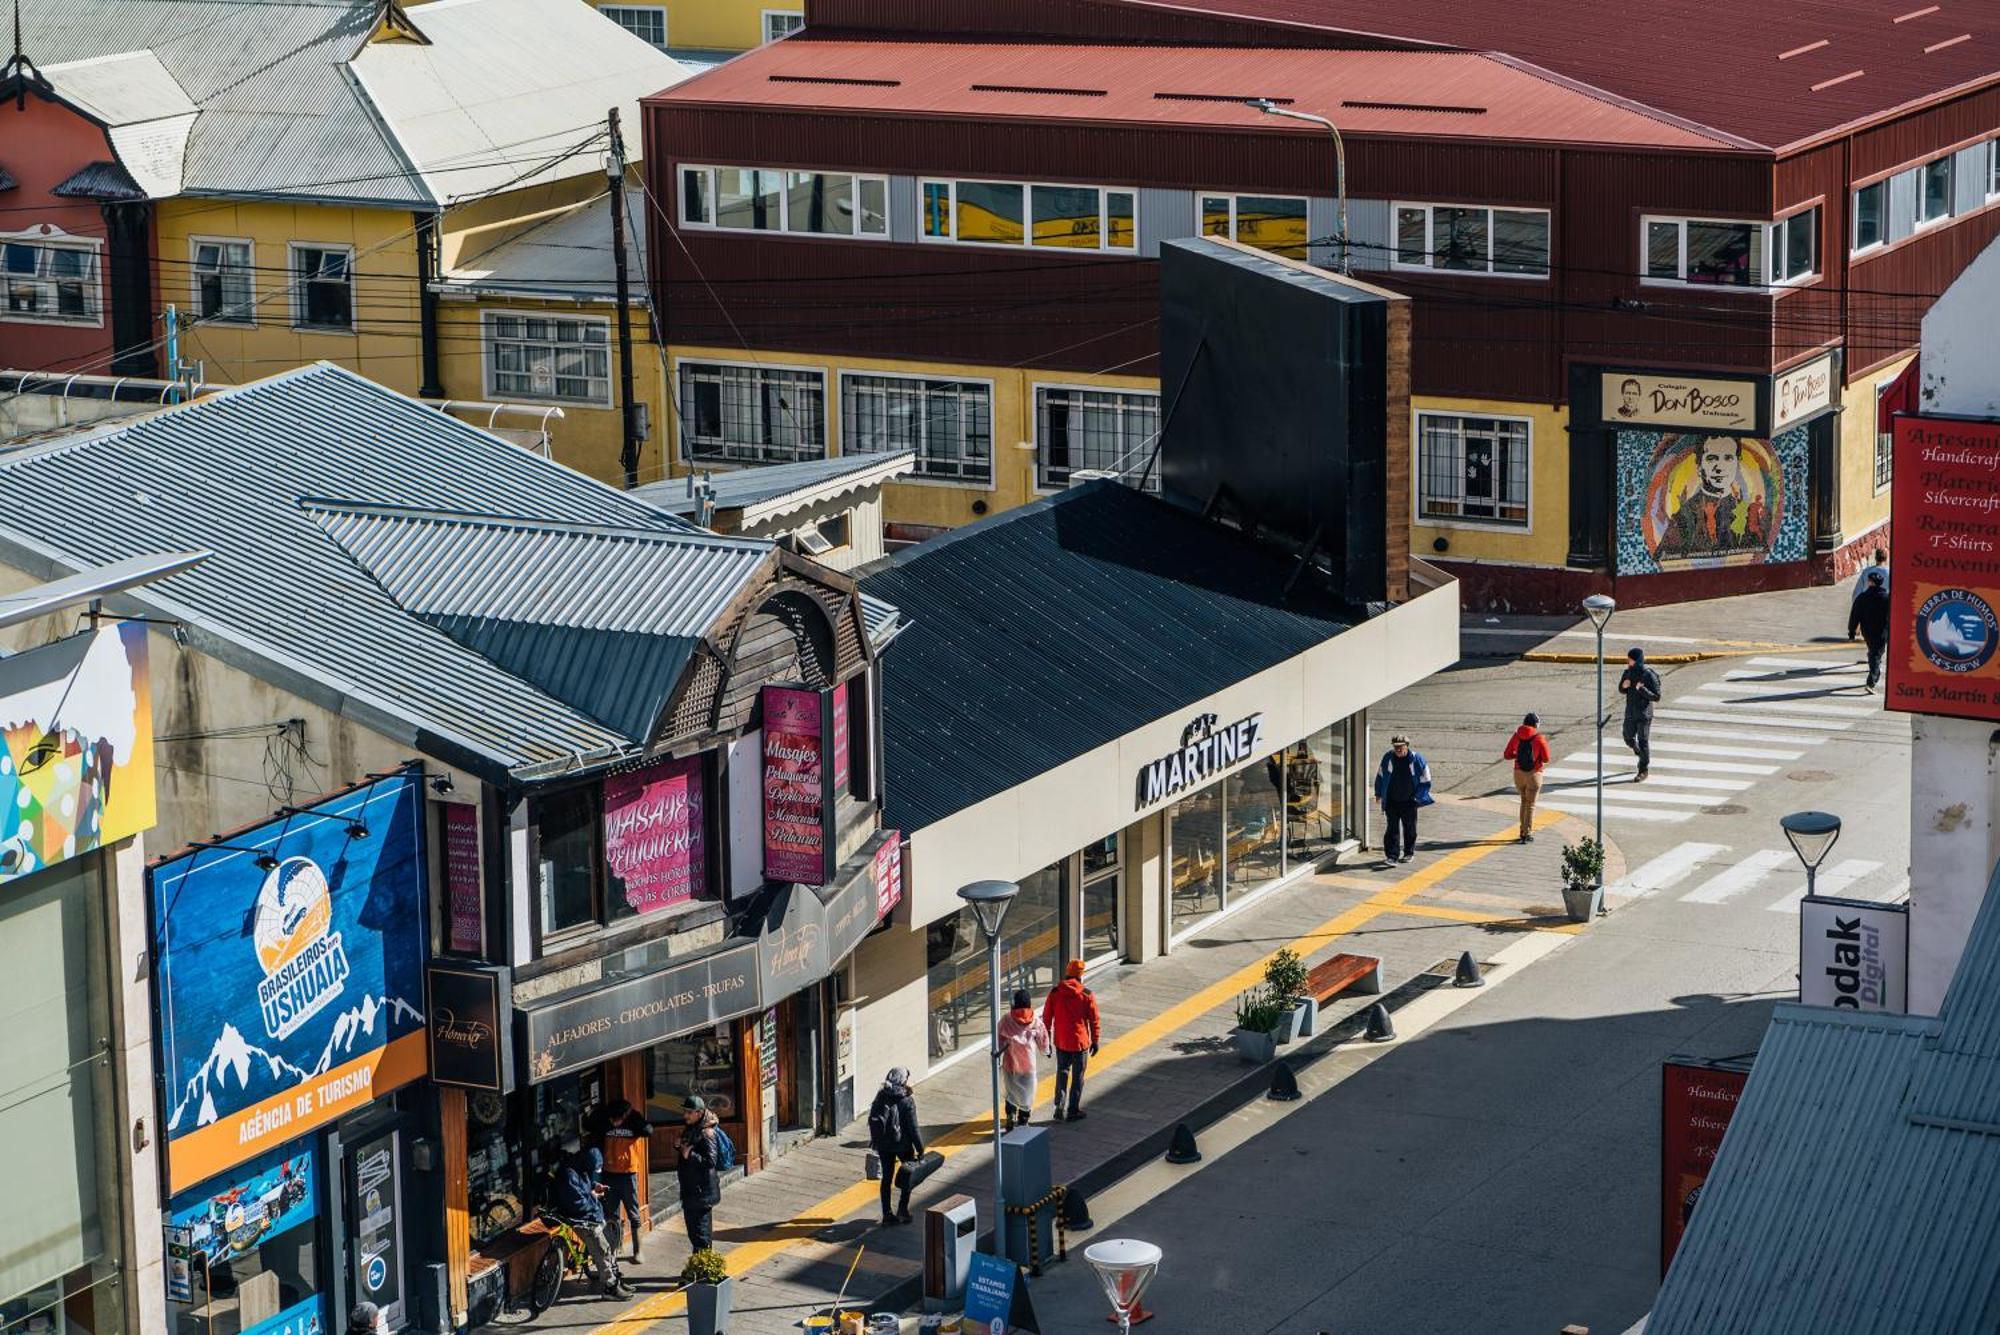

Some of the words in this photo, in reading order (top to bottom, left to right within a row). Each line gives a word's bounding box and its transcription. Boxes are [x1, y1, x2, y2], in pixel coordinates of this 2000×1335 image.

[1930, 533, 1994, 553] T-Shirts
[1919, 591, 1949, 617] TIERRA
[1951, 590, 1965, 600] DE
[1966, 594, 1996, 628] HUMOS
[1896, 683, 1925, 698] San
[767, 740, 817, 766] Masajes
[1141, 713, 1263, 806] MARTINEZ
[606, 790, 702, 838] MASAJES
[260, 936, 328, 1003] BRASILEIROS
[264, 946, 347, 1035] USHUAIA
[1861, 924, 1882, 1004] Digital
[548, 1016, 611, 1047] ALFAJORES
[619, 990, 694, 1025] CHOCOLATES
[702, 974, 745, 998] TRUFAS
[239, 1102, 293, 1145] AGÊNCIA
[296, 1091, 313, 1118] DE
[317, 1065, 372, 1109] TURISMO
